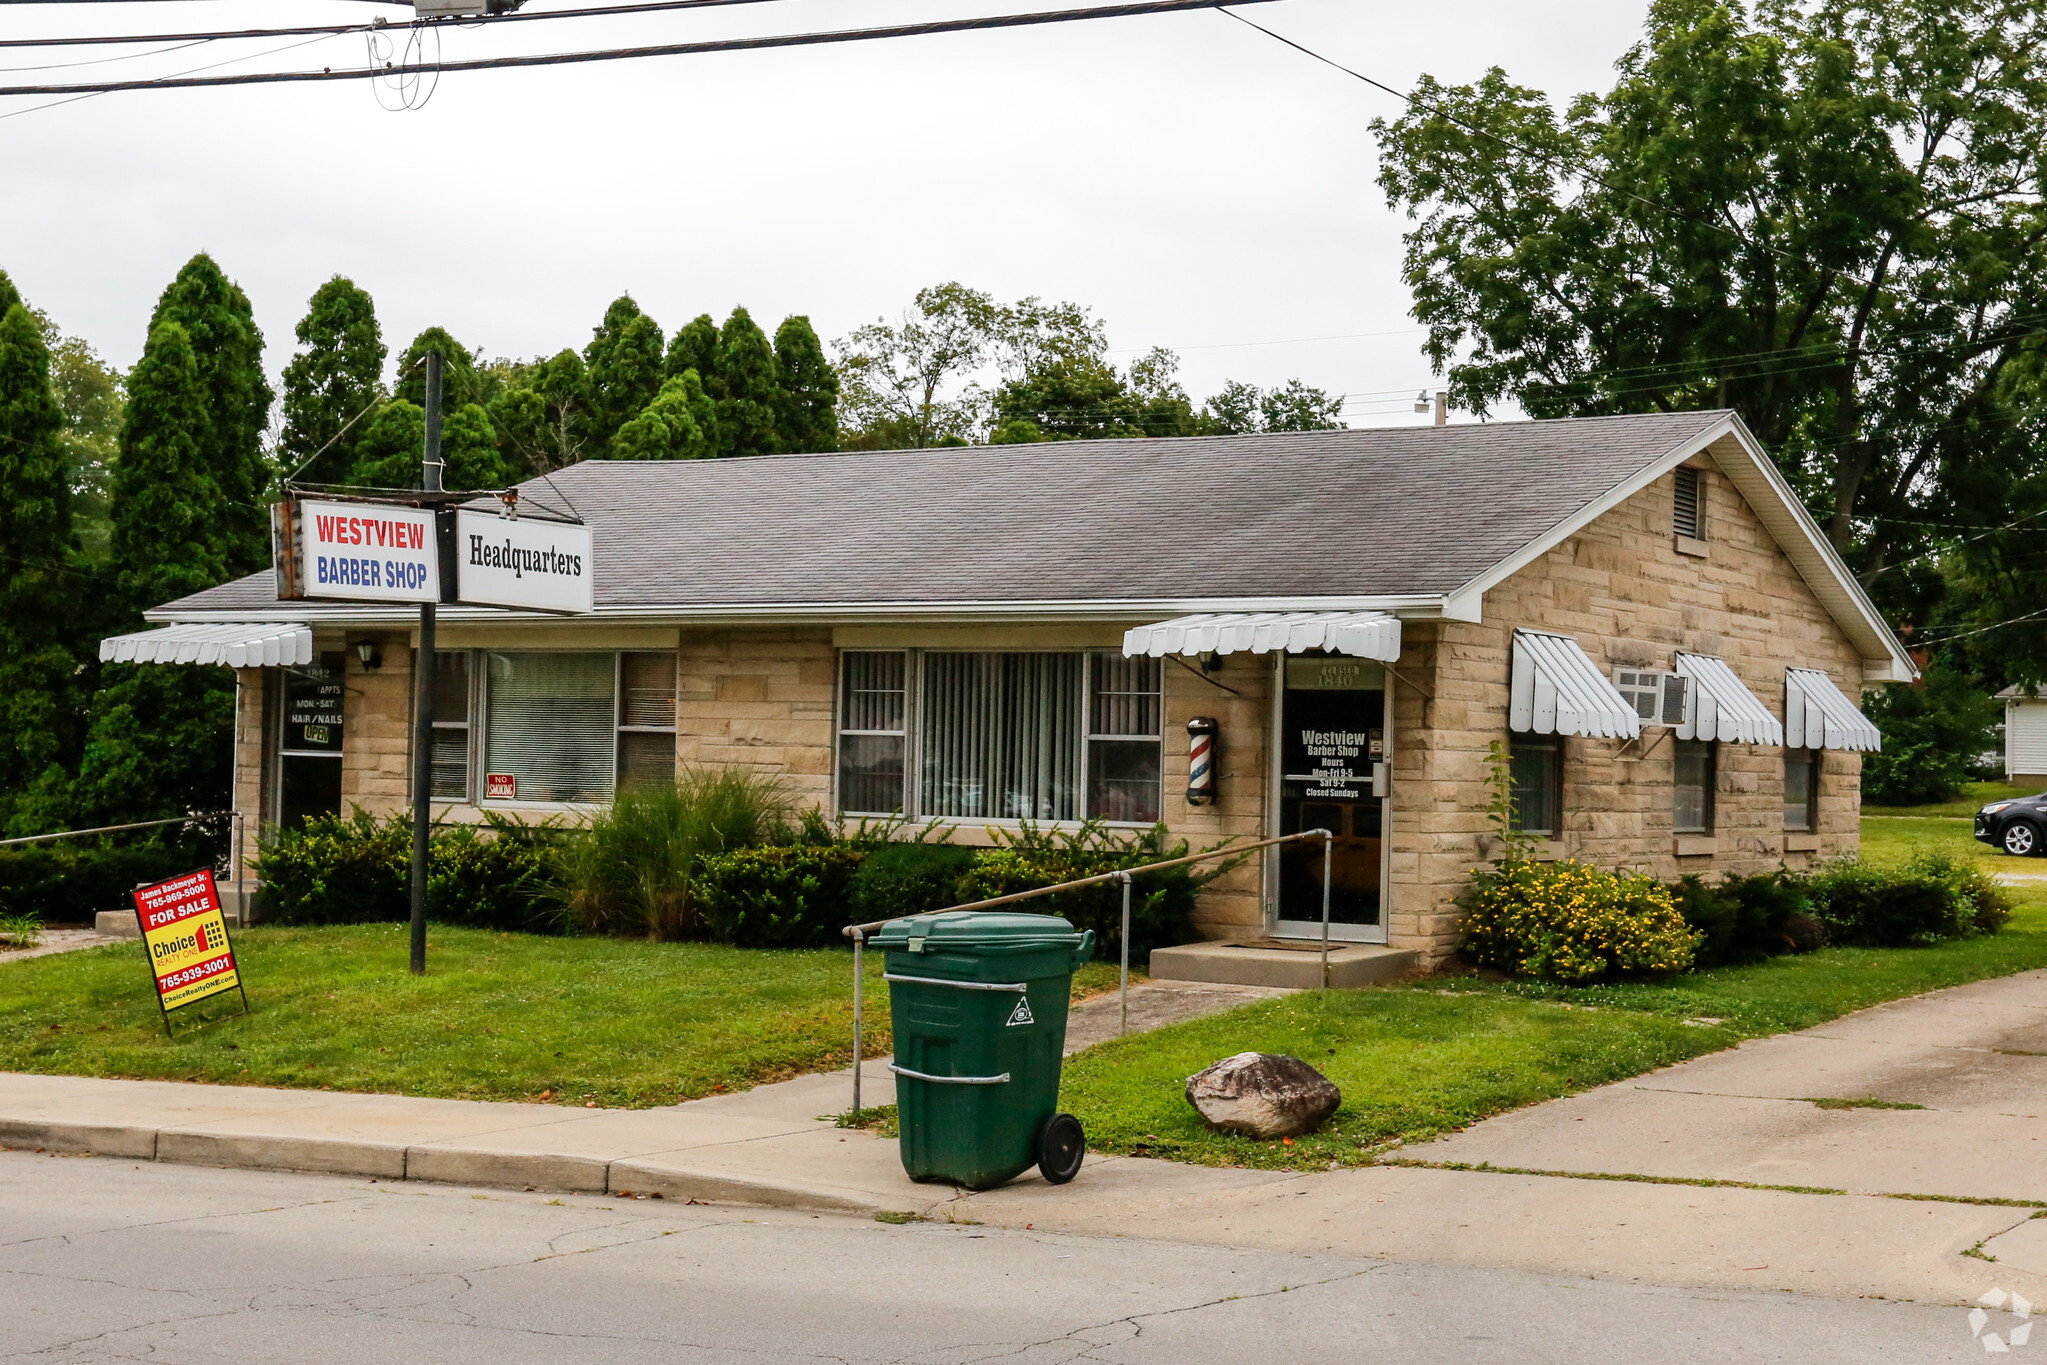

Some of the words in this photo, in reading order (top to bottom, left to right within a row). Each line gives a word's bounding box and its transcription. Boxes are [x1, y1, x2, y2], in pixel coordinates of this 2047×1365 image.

[316, 514, 424, 550] WESTVIEW
[469, 534, 582, 579] Headquarters
[317, 556, 381, 588] BARBER
[385, 561, 427, 590] SHOP
[1319, 675, 1353, 688] 1840
[305, 725, 329, 742] OPEN
[1301, 730, 1365, 746] Westview
[1307, 745, 1336, 756] Barber
[1337, 745, 1359, 758] Shop
[1312, 768, 1340, 778] Mon-Fri
[1340, 768, 1353, 778] 9-5
[1321, 758, 1344, 767] Hours
[489, 784, 513, 795] SMOKING
[1306, 788, 1329, 797] Closed
[1330, 788, 1359, 798] Sundays
[1320, 779, 1333, 787] Sat
[1333, 779, 1345, 788] 9-2
[140, 889, 162, 901] James
[197, 873, 207, 882] Sr.
[146, 883, 206, 910] 765-969-5000
[149, 908, 176, 926] FOR
[177, 897, 210, 917] SALE
[153, 935, 196, 958] Choice
[156, 953, 181, 967] REALTY
[182, 946, 199, 959] ONE
[160, 956, 230, 990] 765-939-3001
[163, 974, 235, 1004] ChoiceRealtyONE.com
